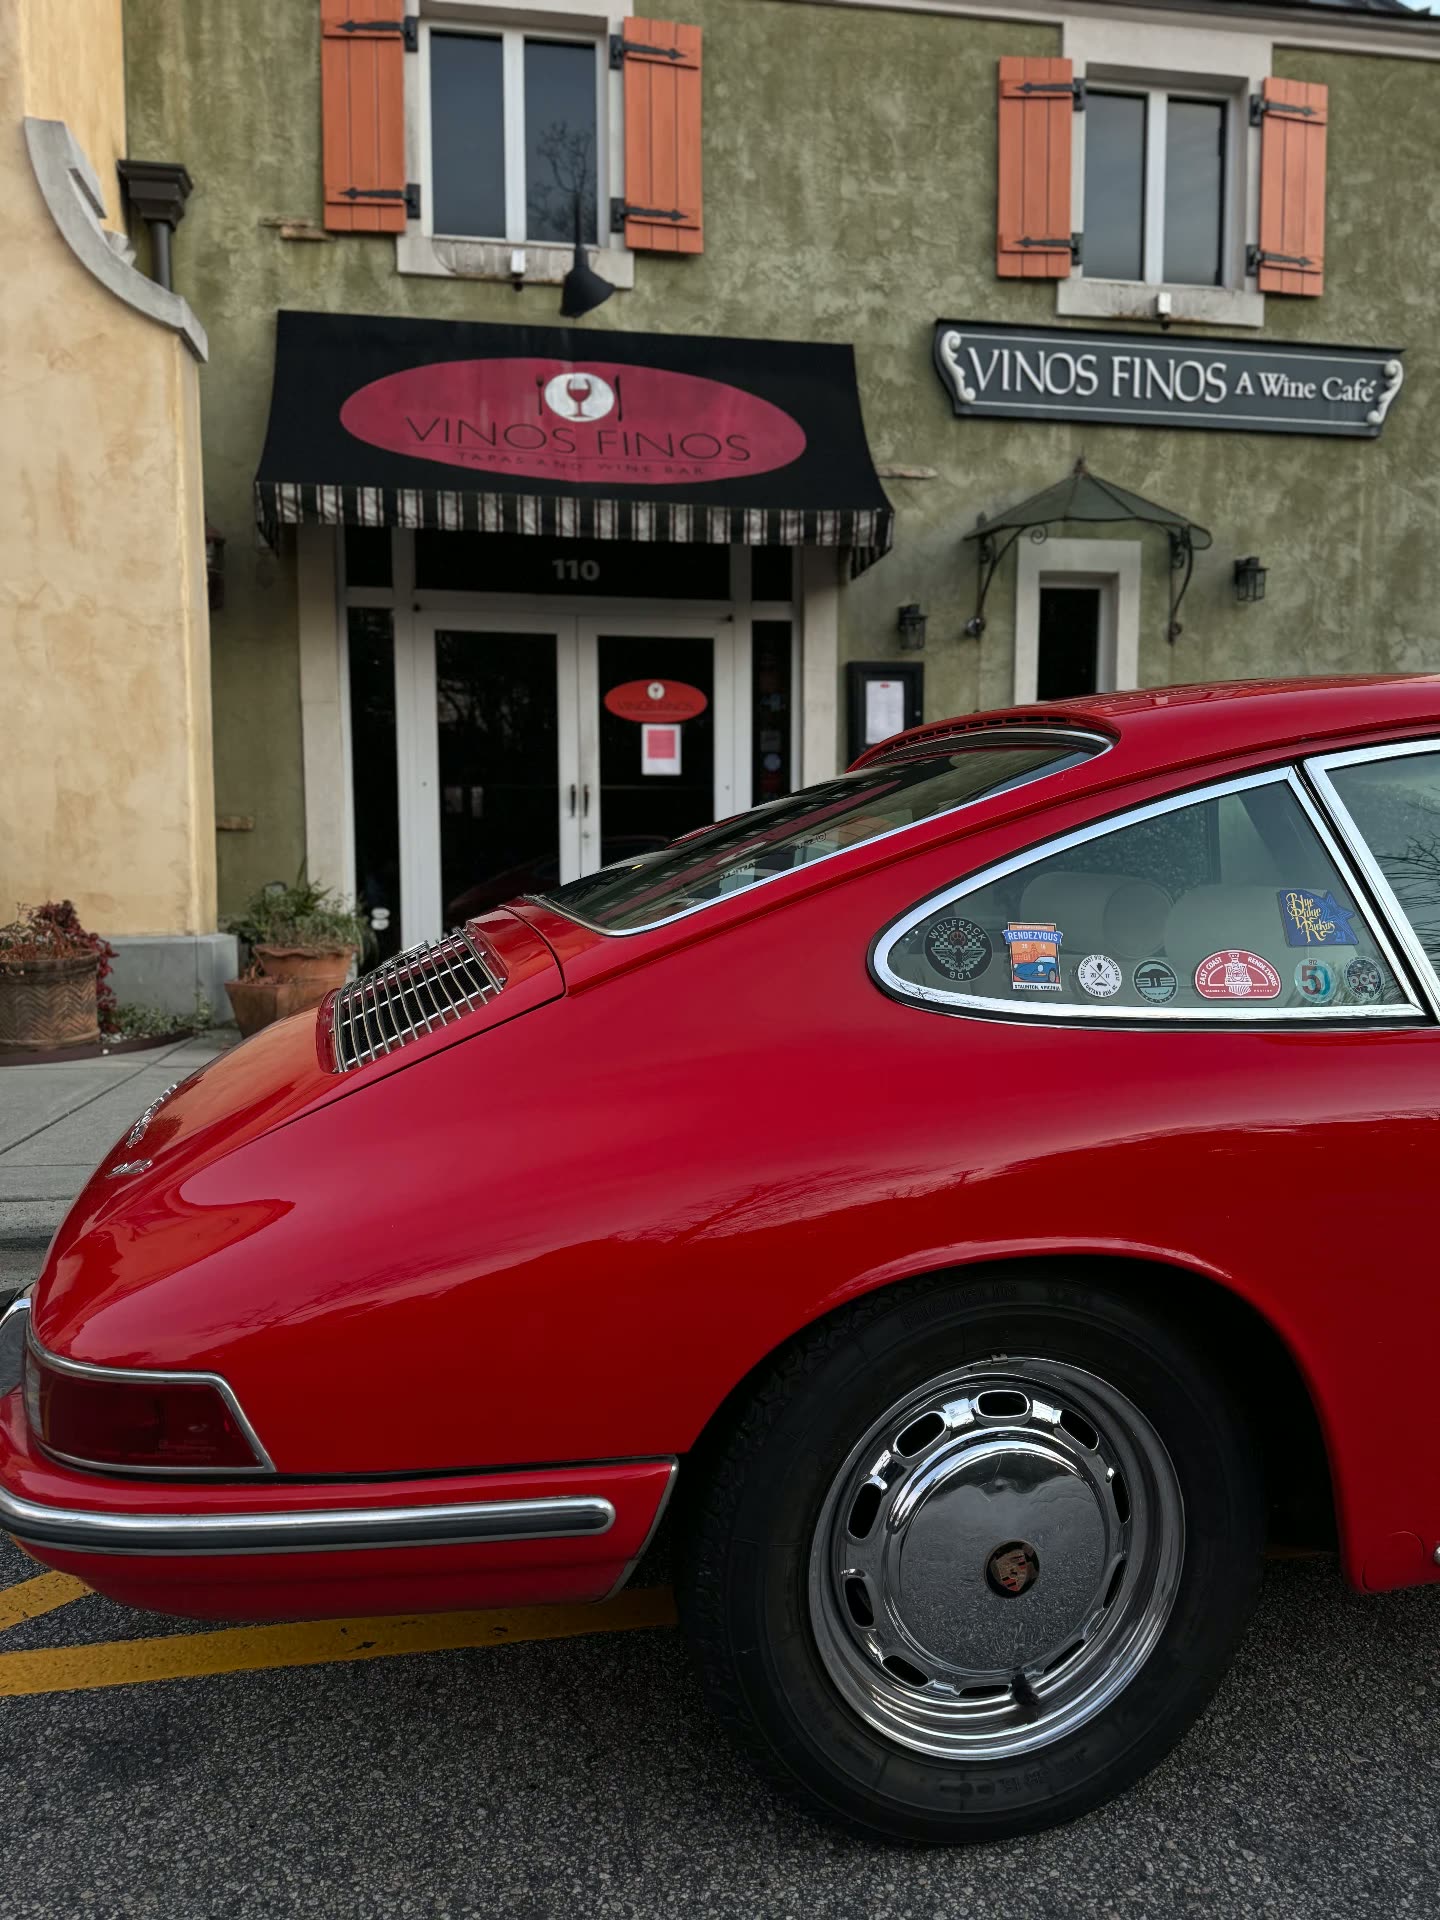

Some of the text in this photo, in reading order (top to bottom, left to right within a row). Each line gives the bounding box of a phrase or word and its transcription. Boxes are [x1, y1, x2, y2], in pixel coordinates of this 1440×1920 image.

[967, 347, 1377, 403] VINOS FINOS A Wine Café
[406, 416, 751, 461] VINOS FINOS
[551, 558, 600, 581] 110
[1286, 893, 1314, 915] Blue
[929, 920, 986, 941] WOLFPACK
[1008, 931, 1058, 942] RENDEZVOUS
[950, 971, 971, 980] 901
[1200, 956, 1278, 986] EAST COAST RENDEZVOUS
[1302, 965, 1331, 995] 50
